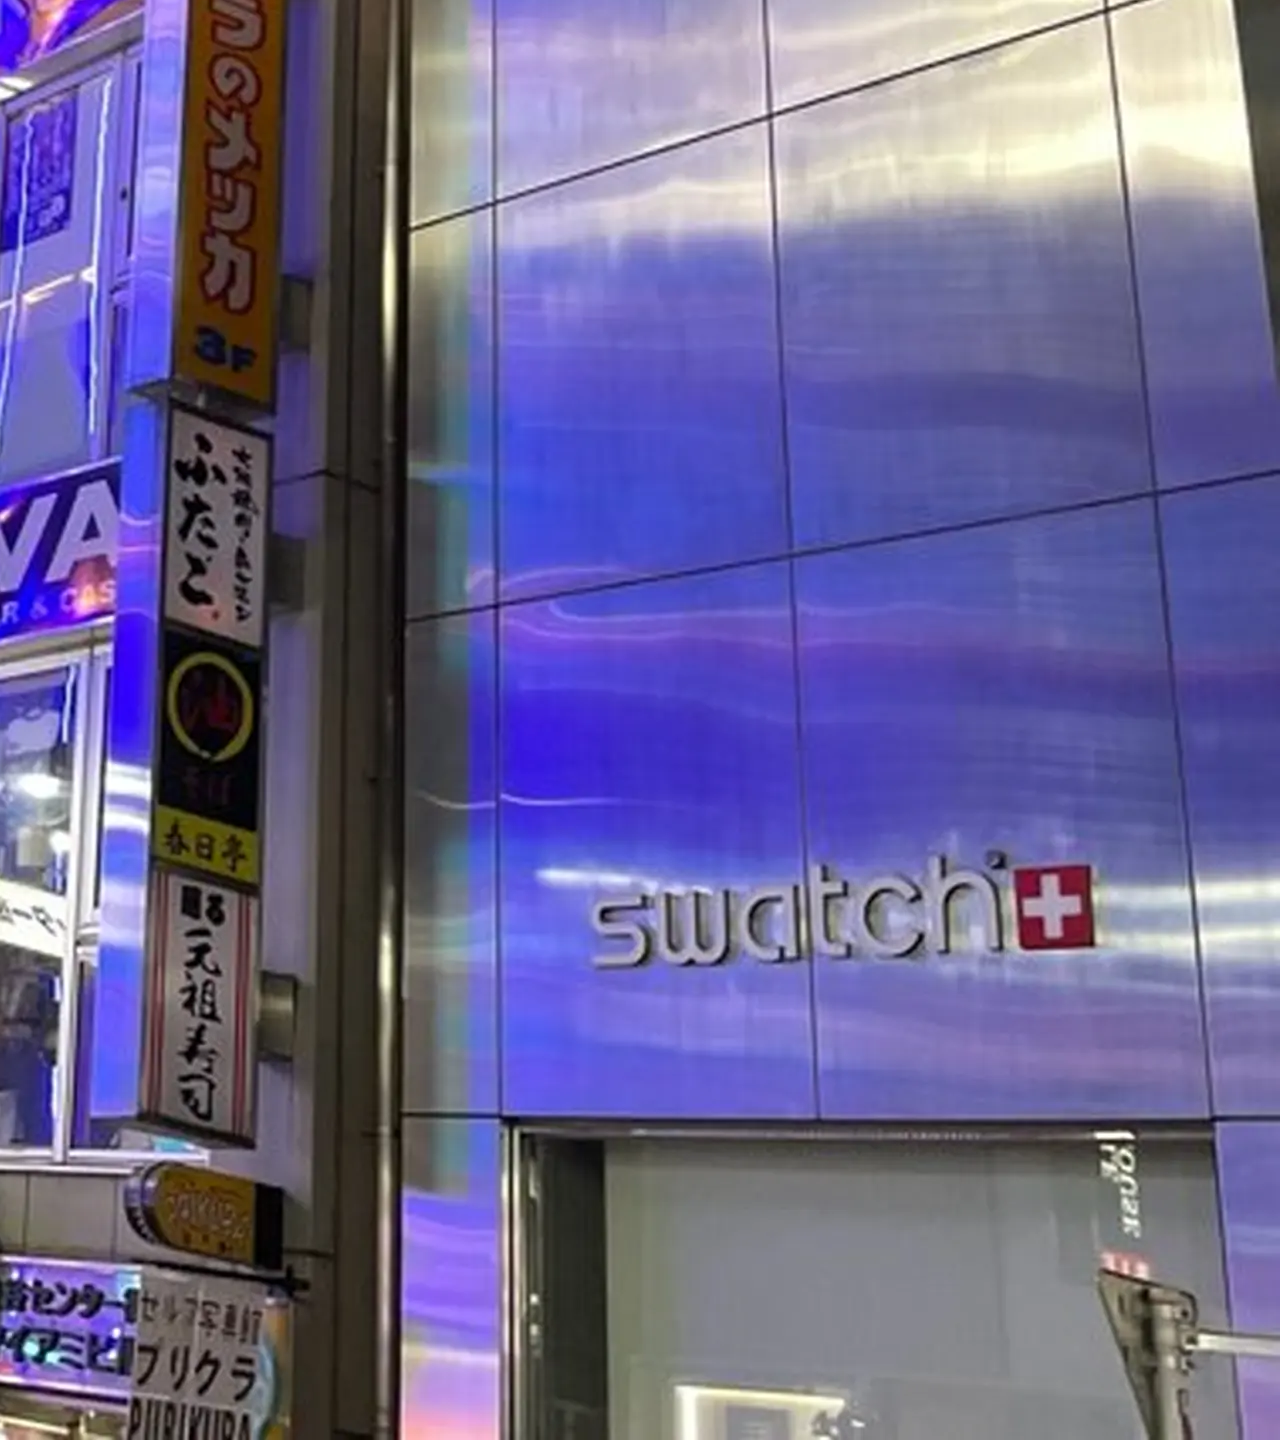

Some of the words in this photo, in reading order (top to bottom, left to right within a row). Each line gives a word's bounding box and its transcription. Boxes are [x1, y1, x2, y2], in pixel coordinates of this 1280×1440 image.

[174, 432, 228, 607] ふたご
[163, 816, 247, 872] 春日亭
[590, 852, 1006, 968] swatch
[177, 927, 223, 1122] 元祖寿司
